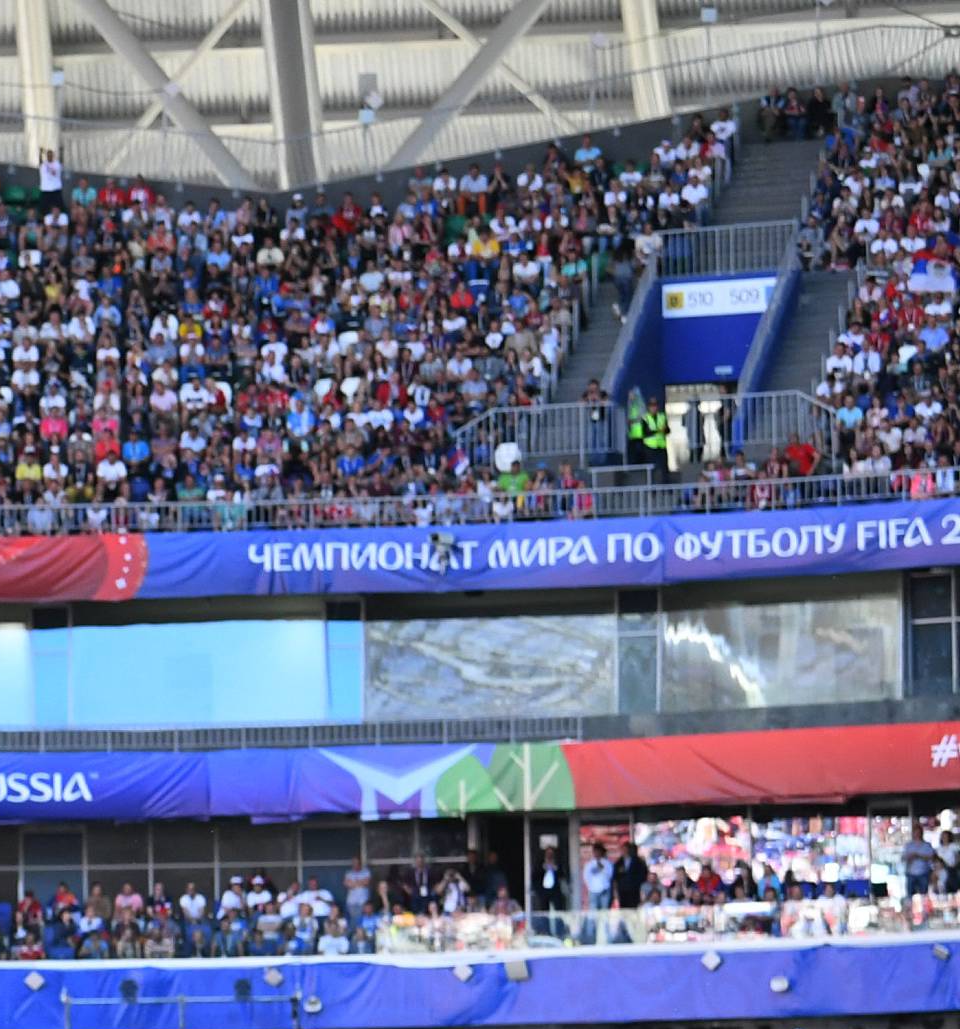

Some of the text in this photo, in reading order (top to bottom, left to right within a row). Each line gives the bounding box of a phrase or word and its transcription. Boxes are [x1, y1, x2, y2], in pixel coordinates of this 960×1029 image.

[488, 535, 599, 569] МИРА
[607, 532, 661, 562] ПО
[674, 522, 846, 561] ФУТБОЛУ
[857, 516, 934, 551] FIFA
